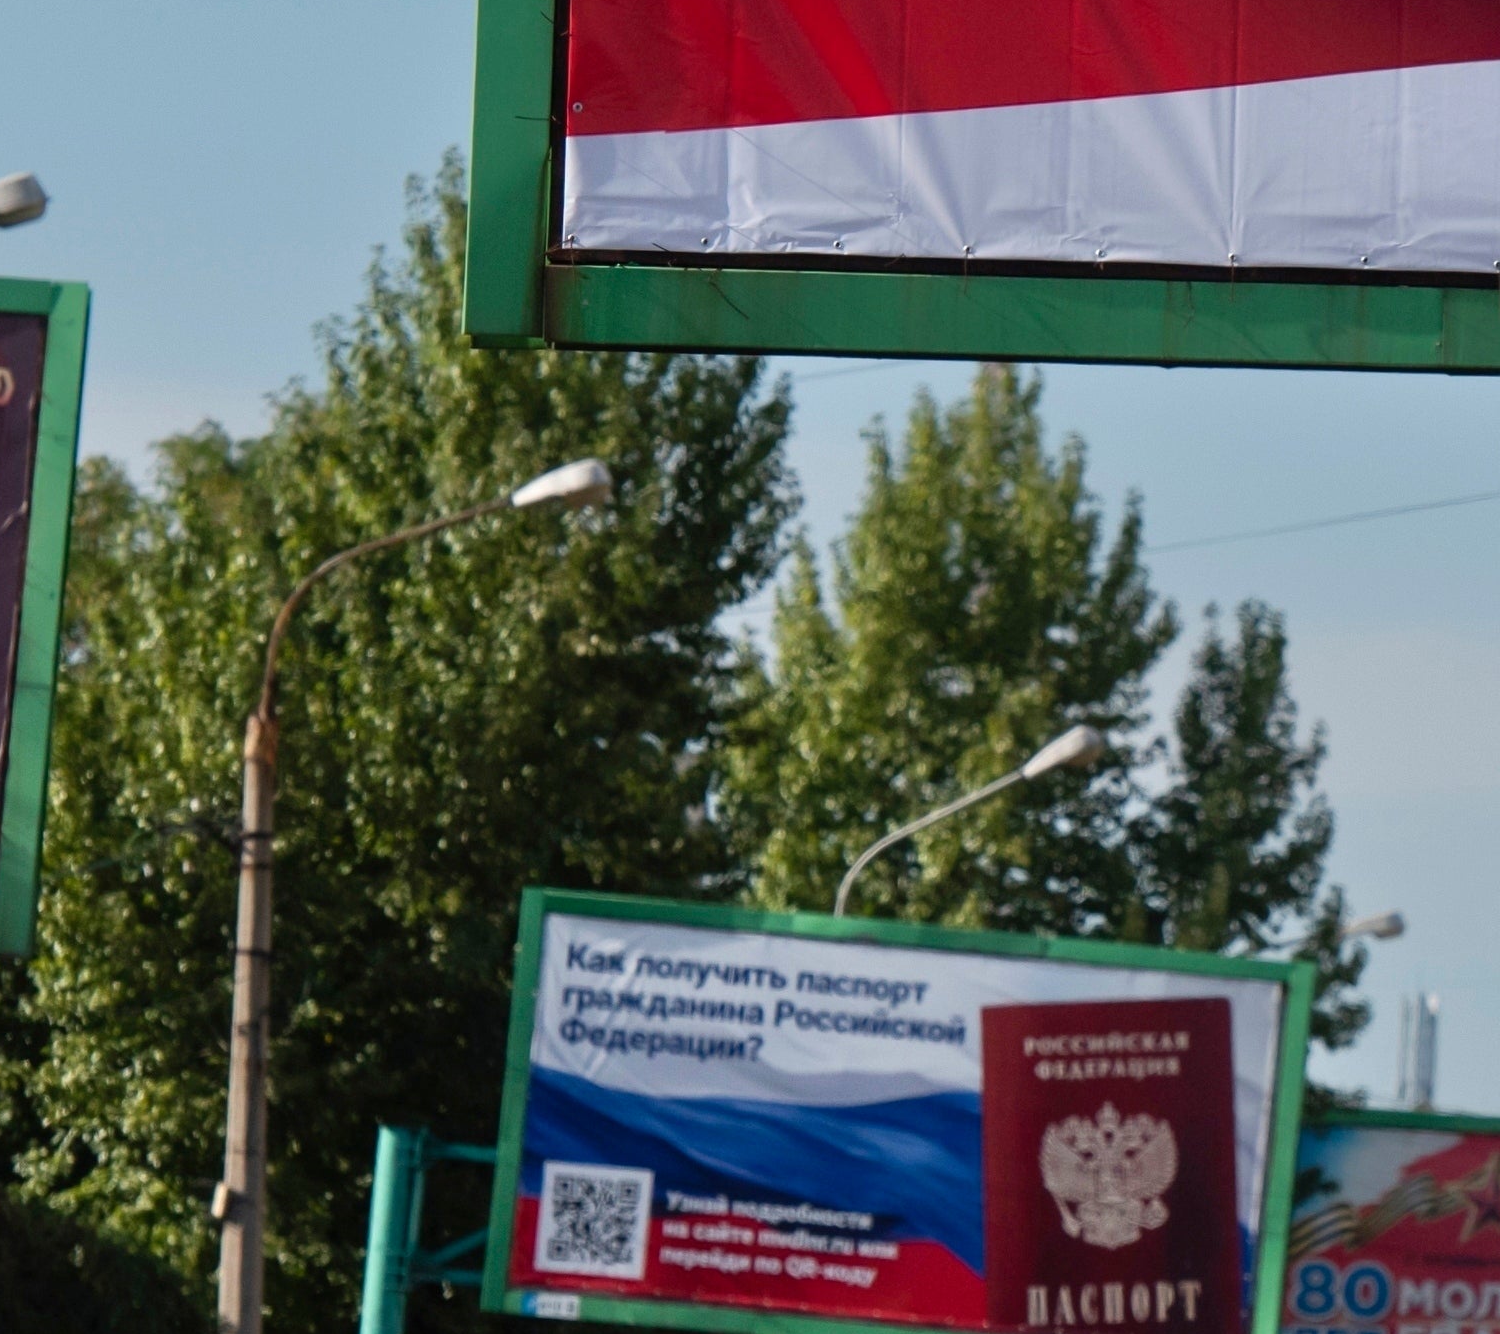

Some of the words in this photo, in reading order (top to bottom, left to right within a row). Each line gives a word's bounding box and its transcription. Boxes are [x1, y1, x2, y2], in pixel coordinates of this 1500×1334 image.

[566, 943, 625, 974] Как
[635, 954, 787, 990] получить
[797, 971, 928, 1007] паспорт
[562, 985, 764, 1023] гражданина
[774, 1000, 967, 1045] Российской
[559, 1019, 764, 1060] Федерации?
[1023, 1030, 1190, 1056] РОССИЙСКАЯ
[1034, 1056, 1181, 1081] ФЕДЕРАЦИЯ
[1027, 1280, 1202, 1326] ПАСПОРТ
[1292, 1259, 1394, 1321] 80
